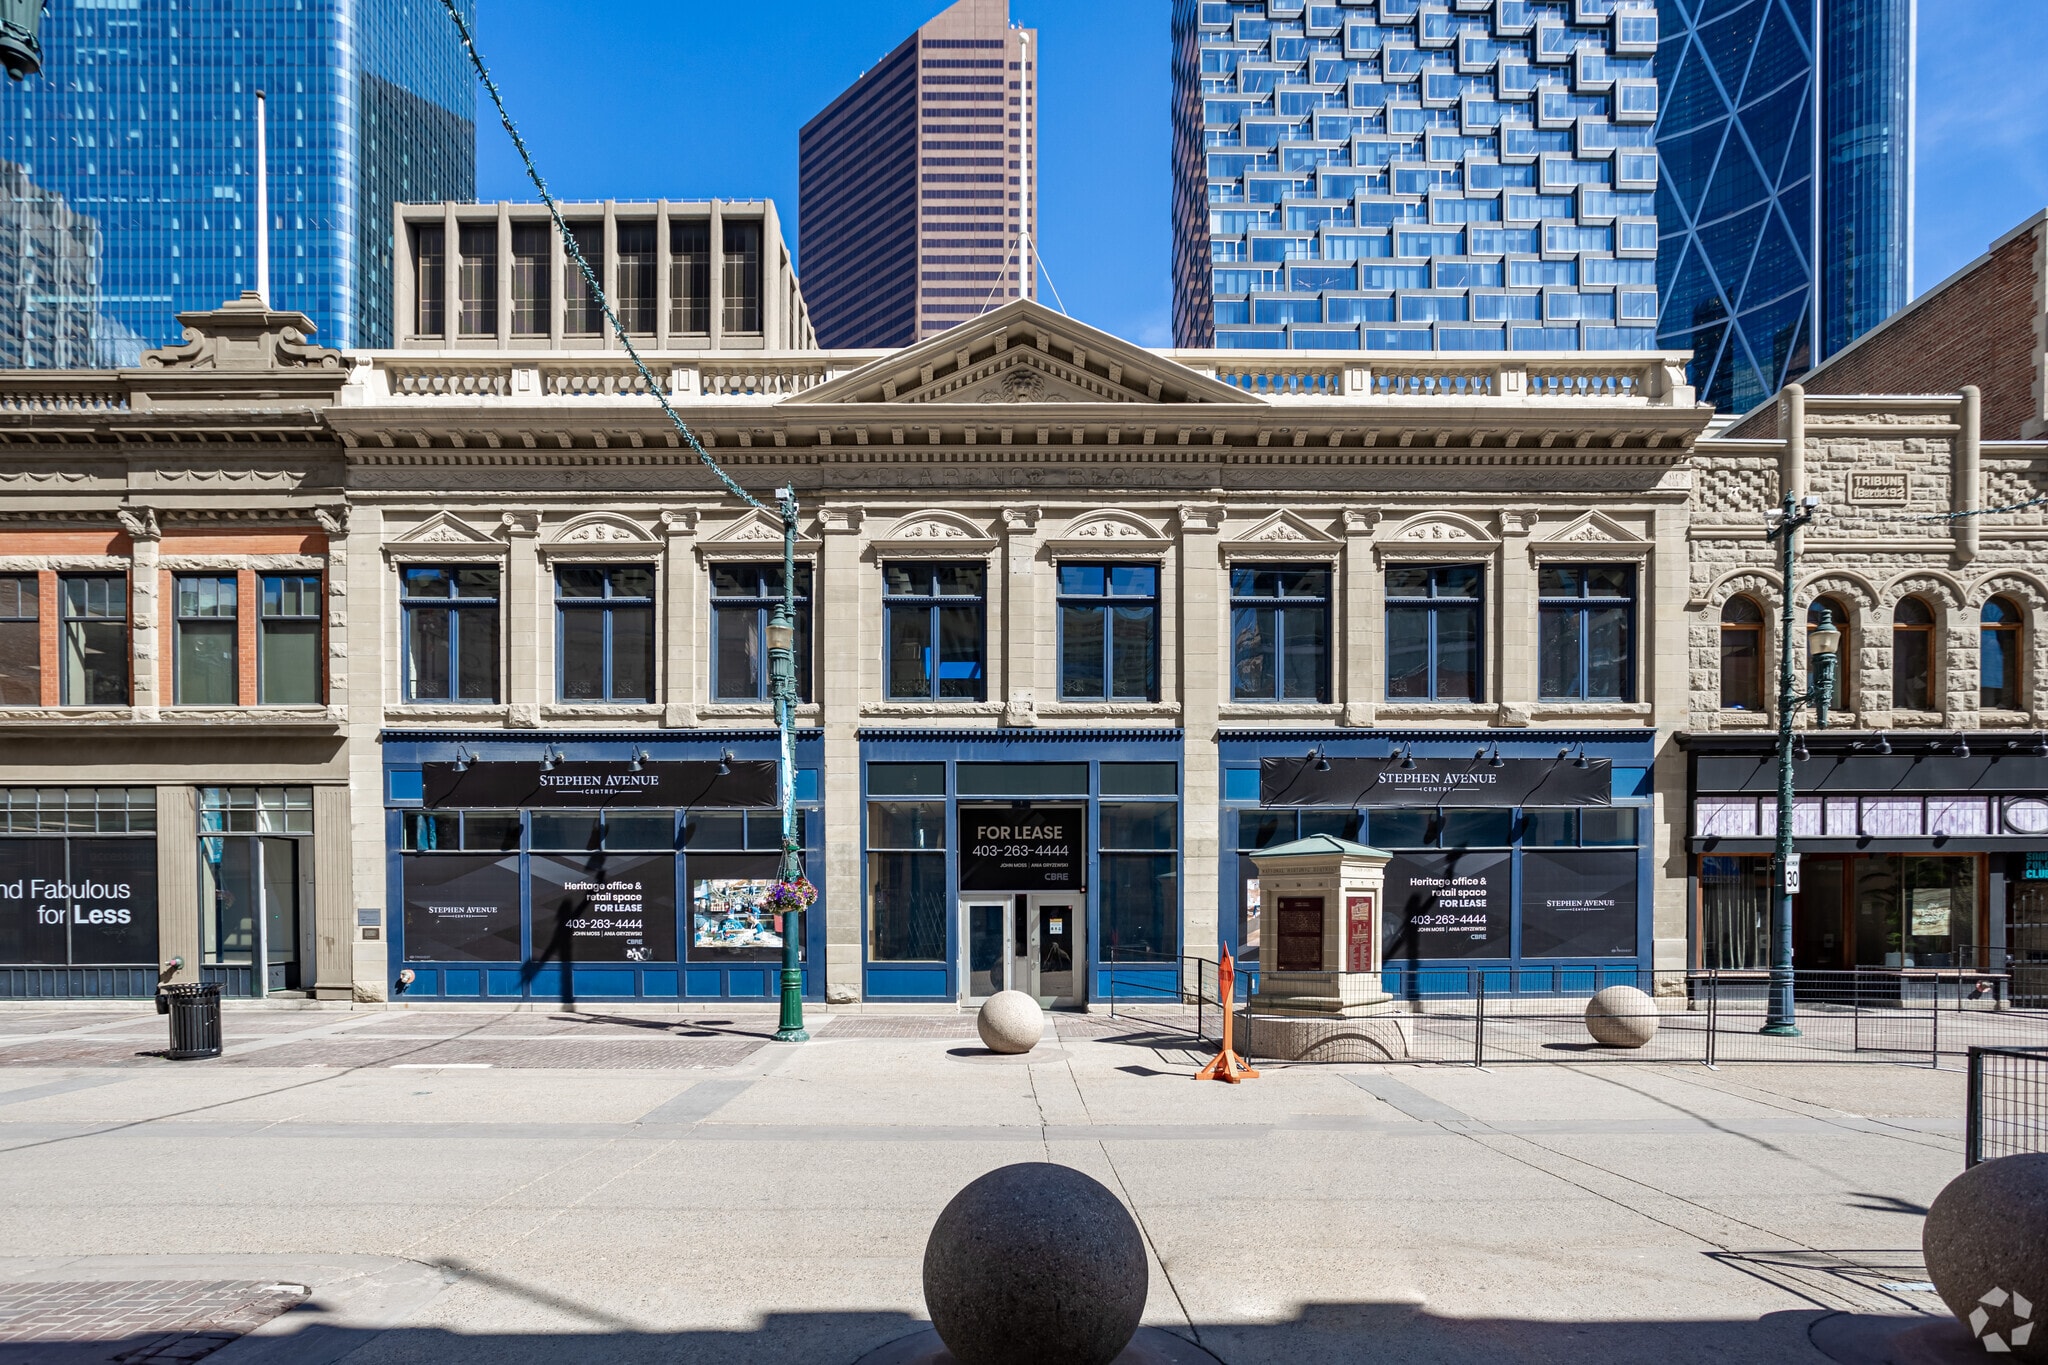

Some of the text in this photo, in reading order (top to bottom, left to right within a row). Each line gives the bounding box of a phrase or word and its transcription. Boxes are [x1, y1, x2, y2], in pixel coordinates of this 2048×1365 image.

[875, 467, 1166, 485] CLARENCE BLOCK
[1854, 476, 1905, 486] TRIBUNE
[539, 774, 659, 786] STEPHEN AVENUE
[1378, 772, 1497, 784] STEPHEN AVENUE
[977, 826, 1063, 840] FOR LEASE
[972, 845, 1069, 857] 403-263-4444
[1044, 873, 1069, 881] CBRE
[1410, 877, 1487, 887] Heritage office &
[1786, 871, 1798, 887] 30
[31, 879, 131, 899] Fabulous
[564, 881, 642, 892] Heritage office &
[587, 892, 642, 903] retail space
[1432, 888, 1487, 898] retail space
[594, 904, 643, 912] FOR LEASE
[1440, 899, 1487, 908] FOR LEASE
[1546, 899, 1615, 907] STEPHEN AVENUE
[37, 904, 132, 924] for Less
[428, 906, 498, 914] STEPHEN AVENUE
[565, 919, 643, 929] 403-263-4444
[1410, 914, 1487, 925] 403-263-4444
